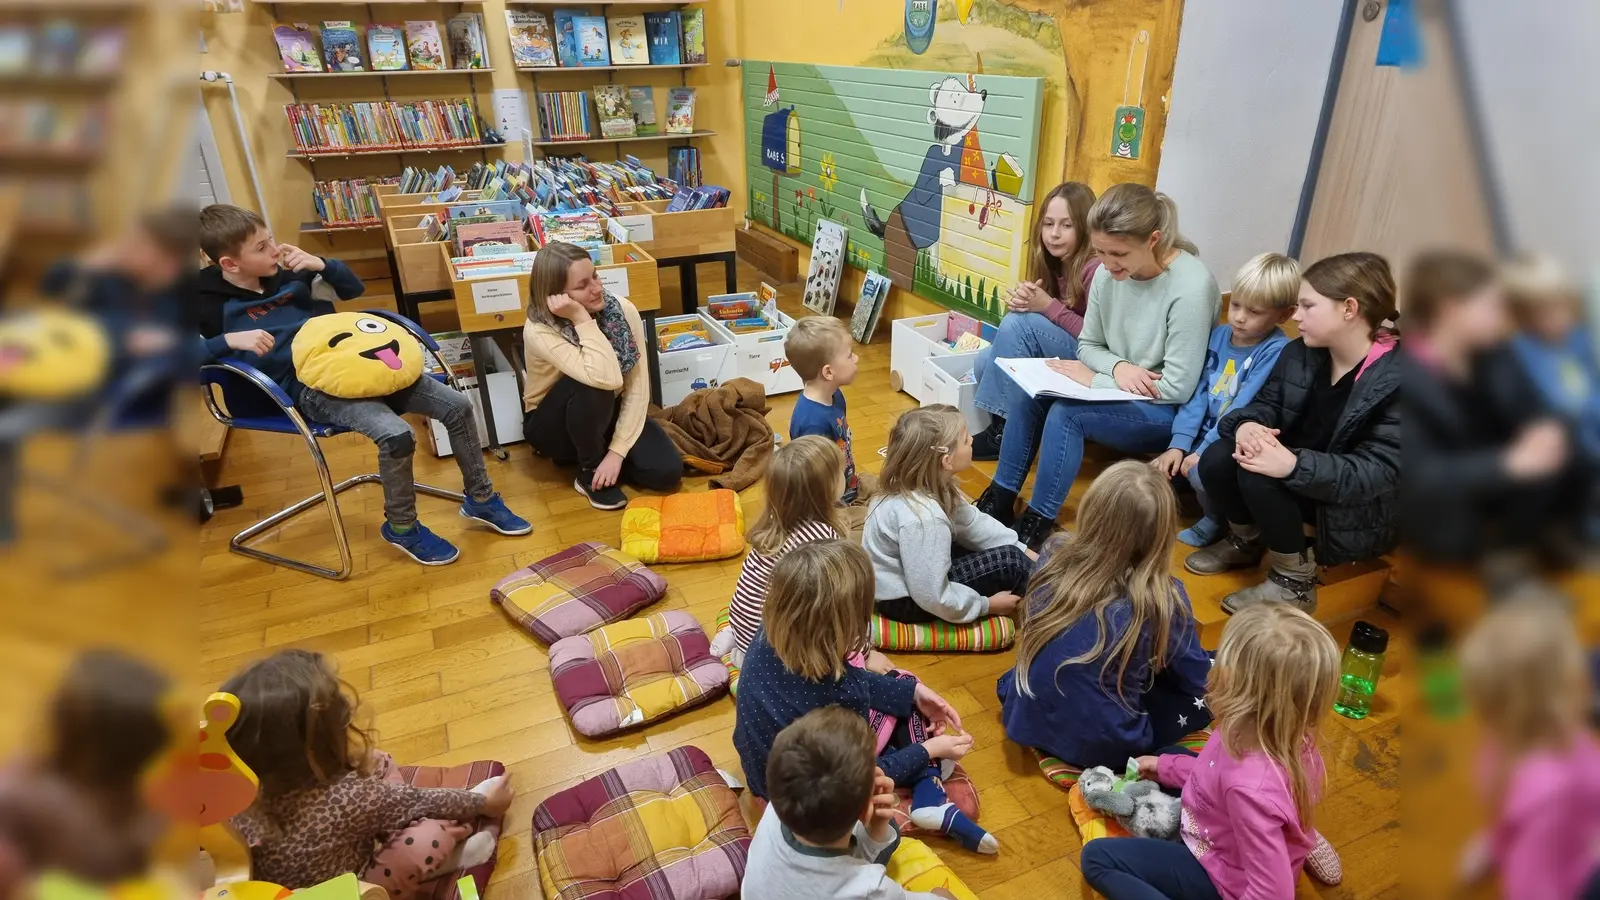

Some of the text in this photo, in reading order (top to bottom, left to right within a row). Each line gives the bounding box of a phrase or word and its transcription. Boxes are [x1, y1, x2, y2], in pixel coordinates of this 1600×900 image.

[653, 36, 669, 46] WIR
[767, 148, 779, 161] RABE
[664, 367, 689, 375] Gemischt
